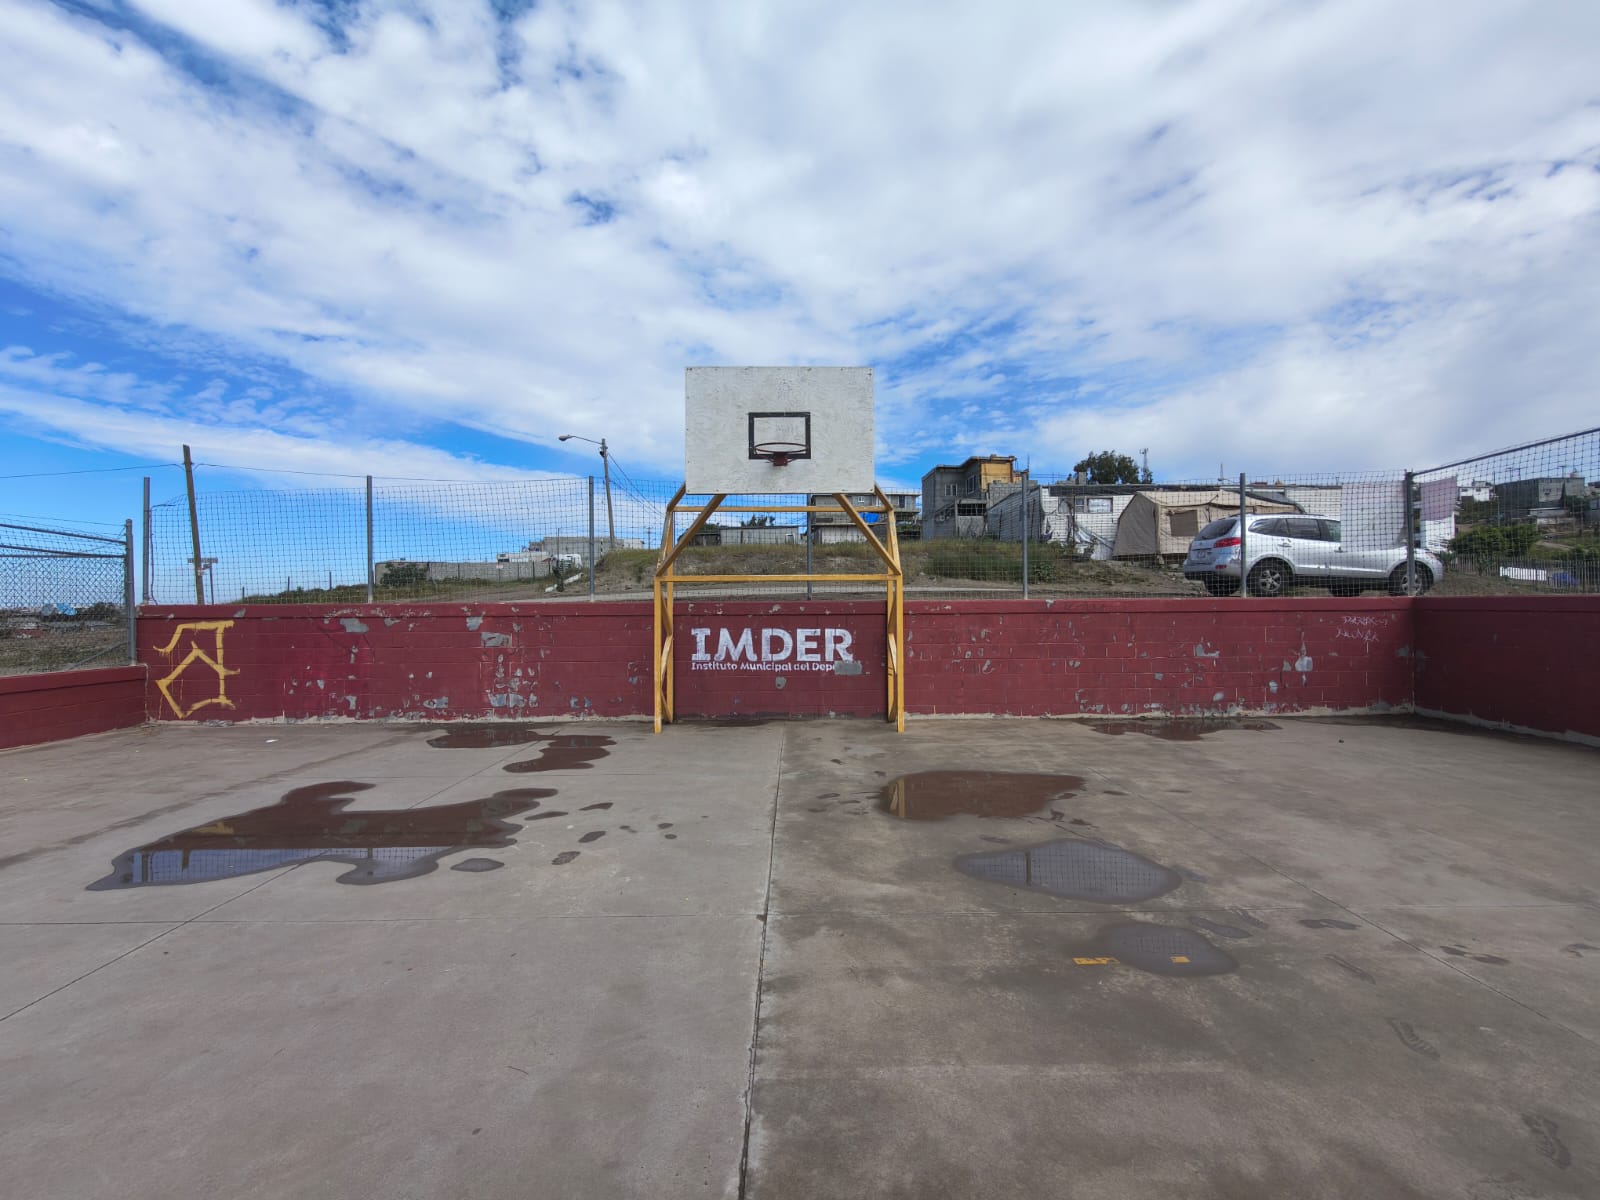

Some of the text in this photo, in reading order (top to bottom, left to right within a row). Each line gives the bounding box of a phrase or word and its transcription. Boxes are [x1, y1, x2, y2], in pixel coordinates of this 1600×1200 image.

[691, 627, 853, 662] IMDER
[691, 661, 737, 671] Instituto
[740, 661, 792, 673] Municipal
[793, 662, 810, 671] del
